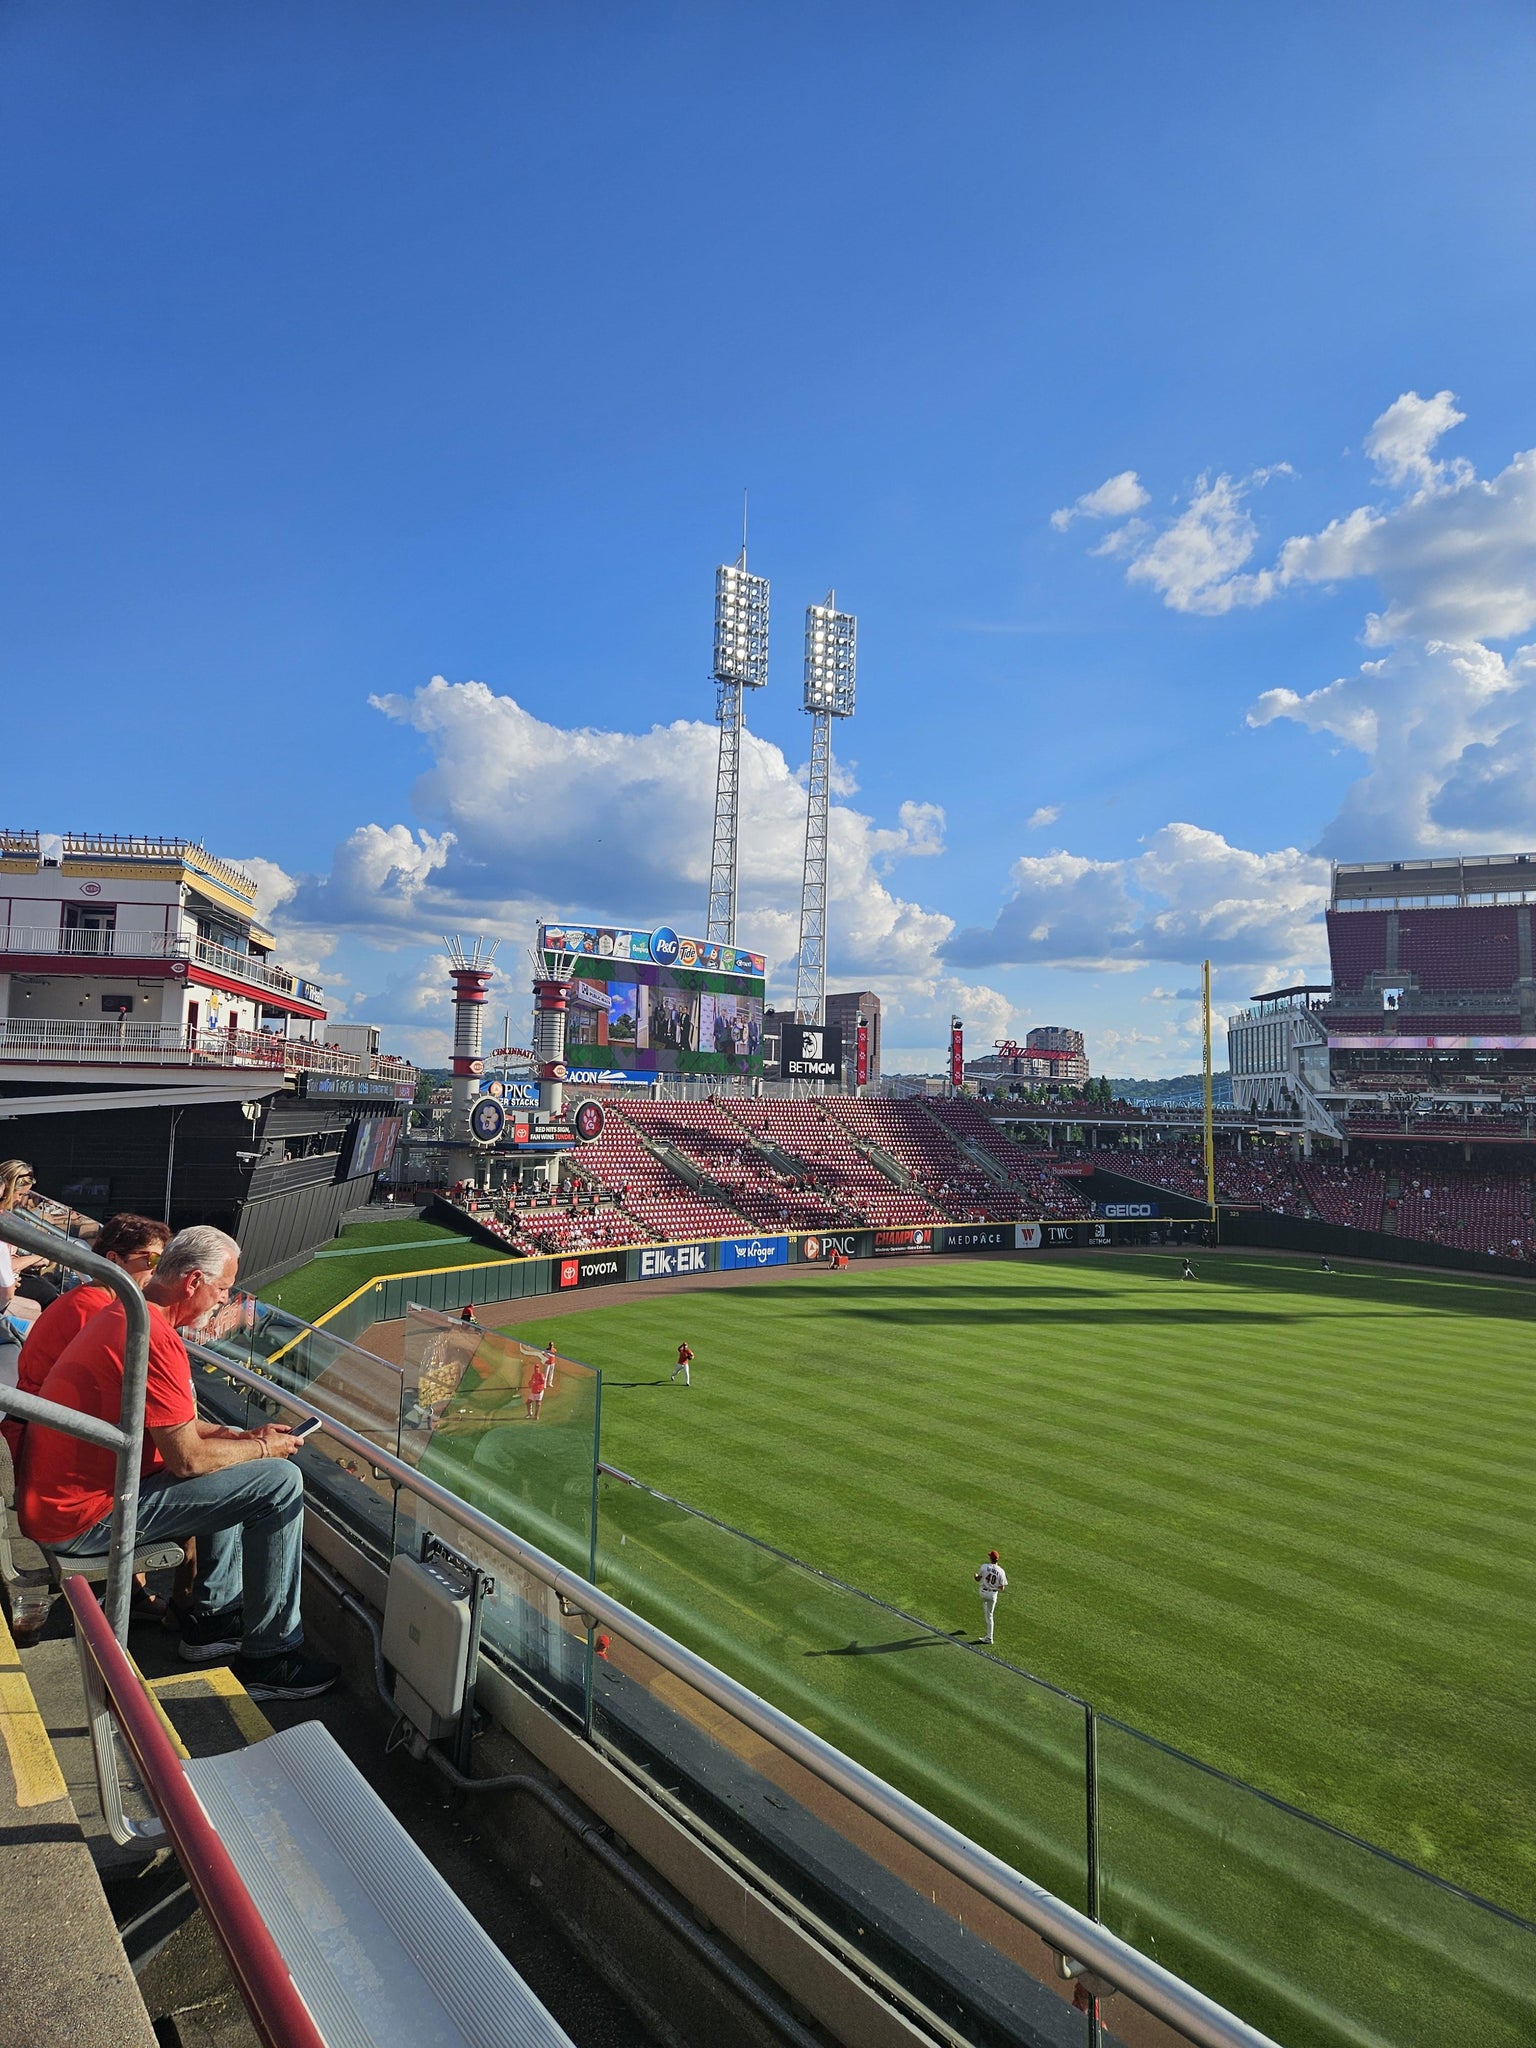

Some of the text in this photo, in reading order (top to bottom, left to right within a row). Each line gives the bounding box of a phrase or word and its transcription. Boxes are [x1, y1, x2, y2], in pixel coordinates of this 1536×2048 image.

[656, 939, 677, 954] P&G
[680, 946, 695, 960] Tide
[789, 1061, 835, 1075] BETMGM
[504, 1083, 532, 1098] PNC
[511, 1098, 539, 1106] STACKS
[1052, 1167, 1082, 1175] Budweiser
[1105, 1204, 1151, 1217] GEICO
[875, 1230, 931, 1245] CHAMPION
[948, 1232, 1000, 1245] MEDPACE
[1048, 1227, 1073, 1240] TWC
[747, 1241, 775, 1263] Kroger
[821, 1236, 855, 1255] PNC
[580, 1261, 617, 1277] TOYOTA
[160, 1554, 168, 1565] A
[985, 1573, 996, 1585] 40
